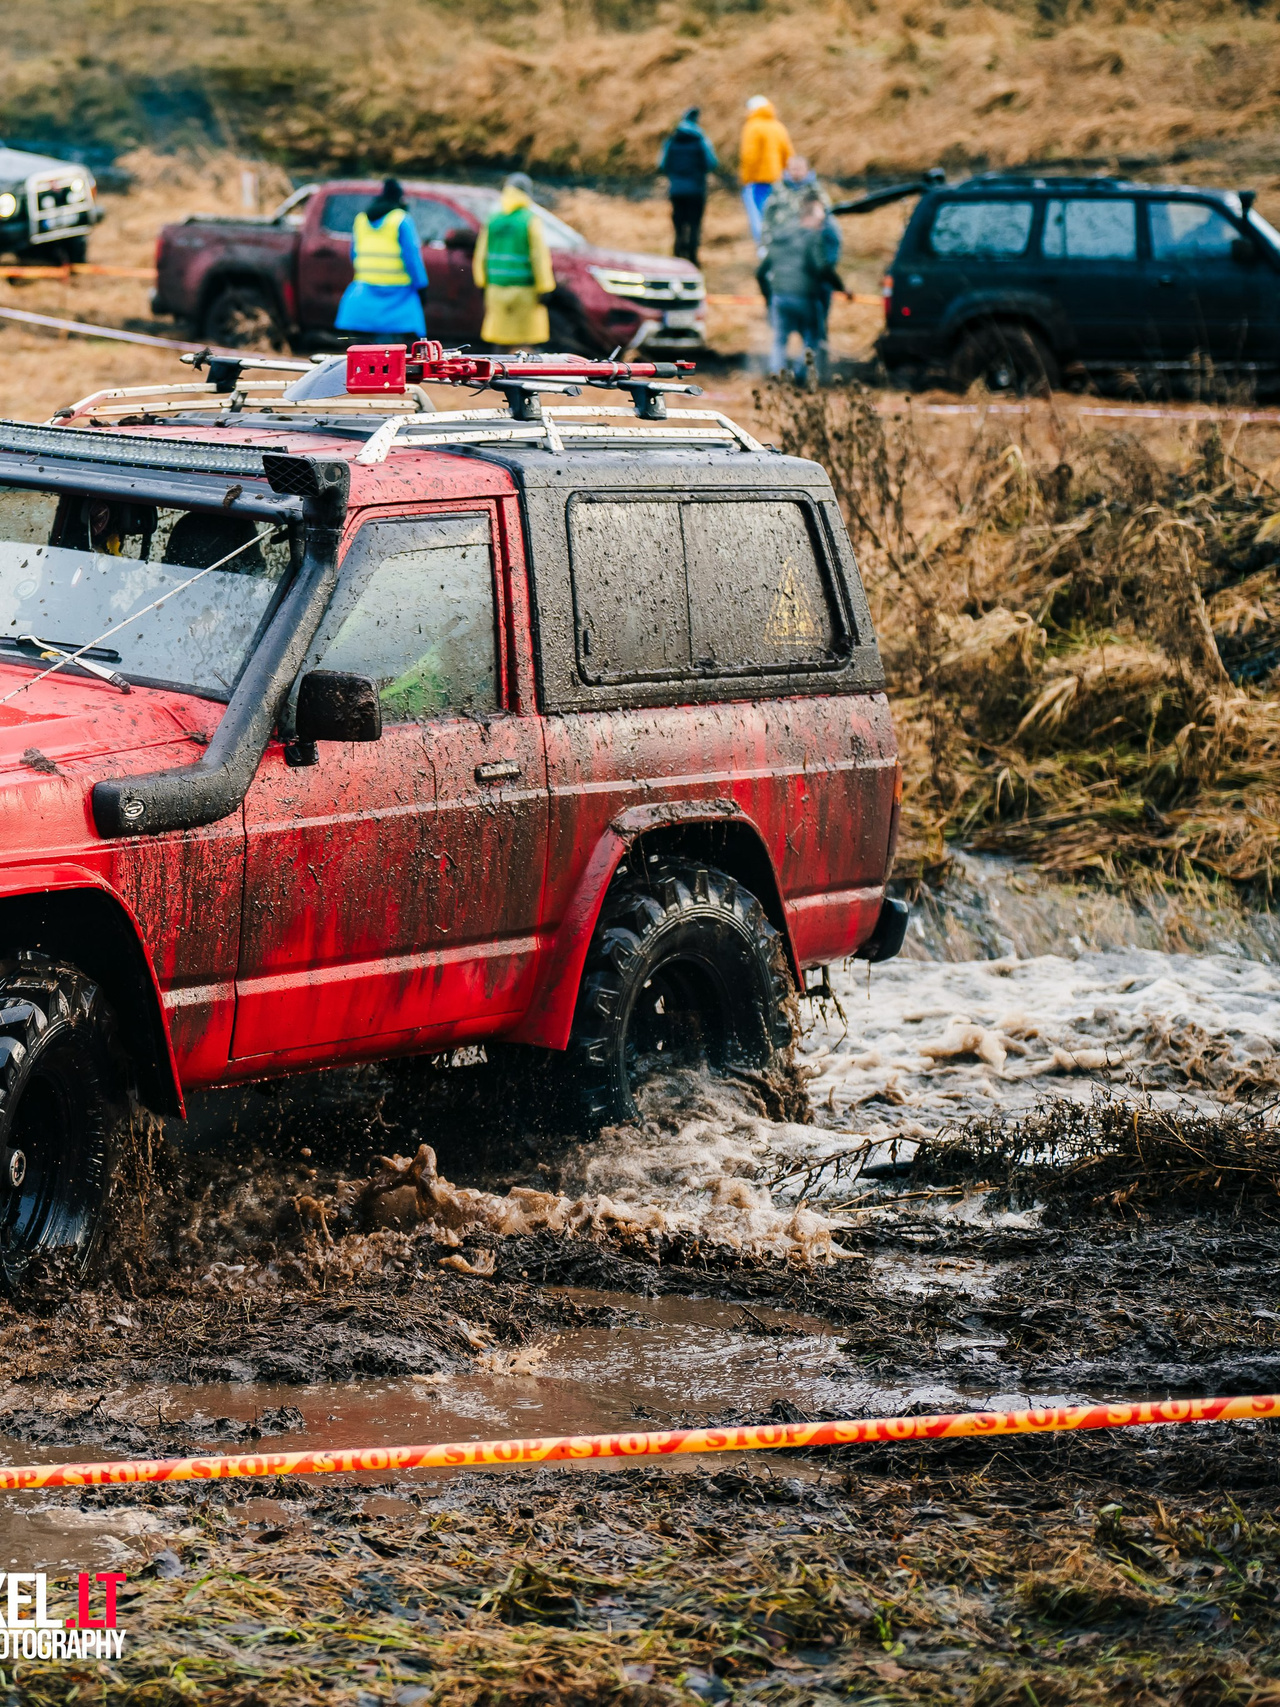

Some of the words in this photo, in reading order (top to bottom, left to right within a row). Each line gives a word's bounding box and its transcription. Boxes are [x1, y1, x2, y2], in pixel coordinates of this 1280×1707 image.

[62, 1463, 159, 1485] STOP
[191, 1456, 287, 1478] STOP
[312, 1448, 411, 1472] STOP
[444, 1440, 543, 1464] STOP
[569, 1432, 669, 1458] STOP
[705, 1425, 808, 1448] STOP
[833, 1415, 939, 1442] STOP
[974, 1406, 1079, 1431] STOP
[1106, 1399, 1218, 1424] STOP
